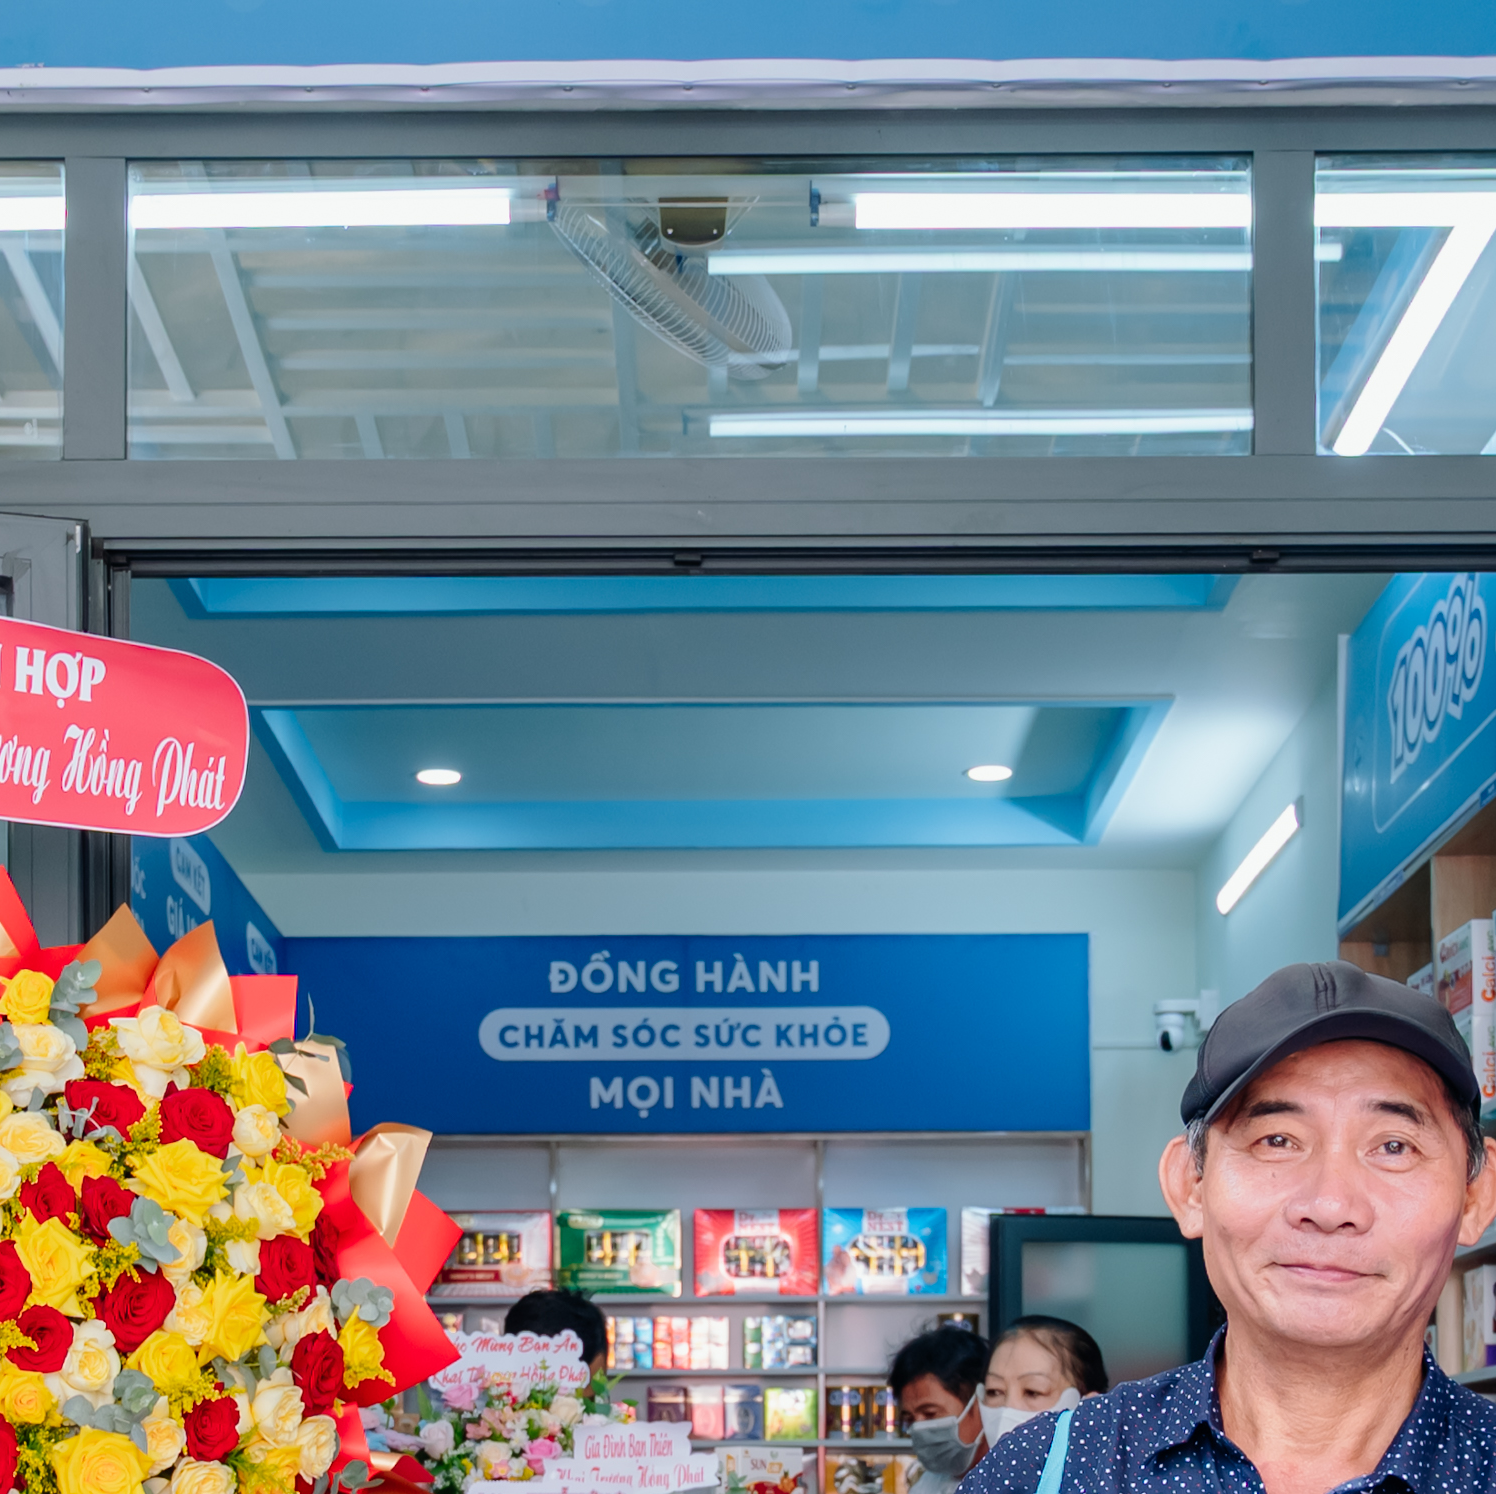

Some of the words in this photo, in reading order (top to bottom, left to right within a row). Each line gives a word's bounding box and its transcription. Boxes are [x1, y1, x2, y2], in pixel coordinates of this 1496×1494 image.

[14, 643, 105, 709] HỢP
[1389, 573, 1487, 784] 100%
[61, 723, 144, 816] Hồng
[152, 737, 227, 818] Phát
[548, 950, 681, 994] ĐỒNG
[695, 949, 820, 994] HÀNH
[1481, 955, 1496, 1003] Calci
[498, 1018, 600, 1050] CHĂM
[611, 1016, 682, 1048] SÓC
[694, 1014, 763, 1048] SỨC
[775, 1014, 869, 1048] KHỎE
[589, 1075, 675, 1119] MỌI
[691, 1067, 784, 1110] NHÀ
[1481, 1050, 1496, 1099] Calci
[471, 1336, 514, 1355] Mừng
[518, 1335, 550, 1355] Bạn
[584, 1434, 601, 1460] Gia
[603, 1434, 626, 1459] Đình
[629, 1433, 647, 1463] Bạn
[637, 1464, 670, 1489] Hồng
[674, 1463, 705, 1488] Phát
